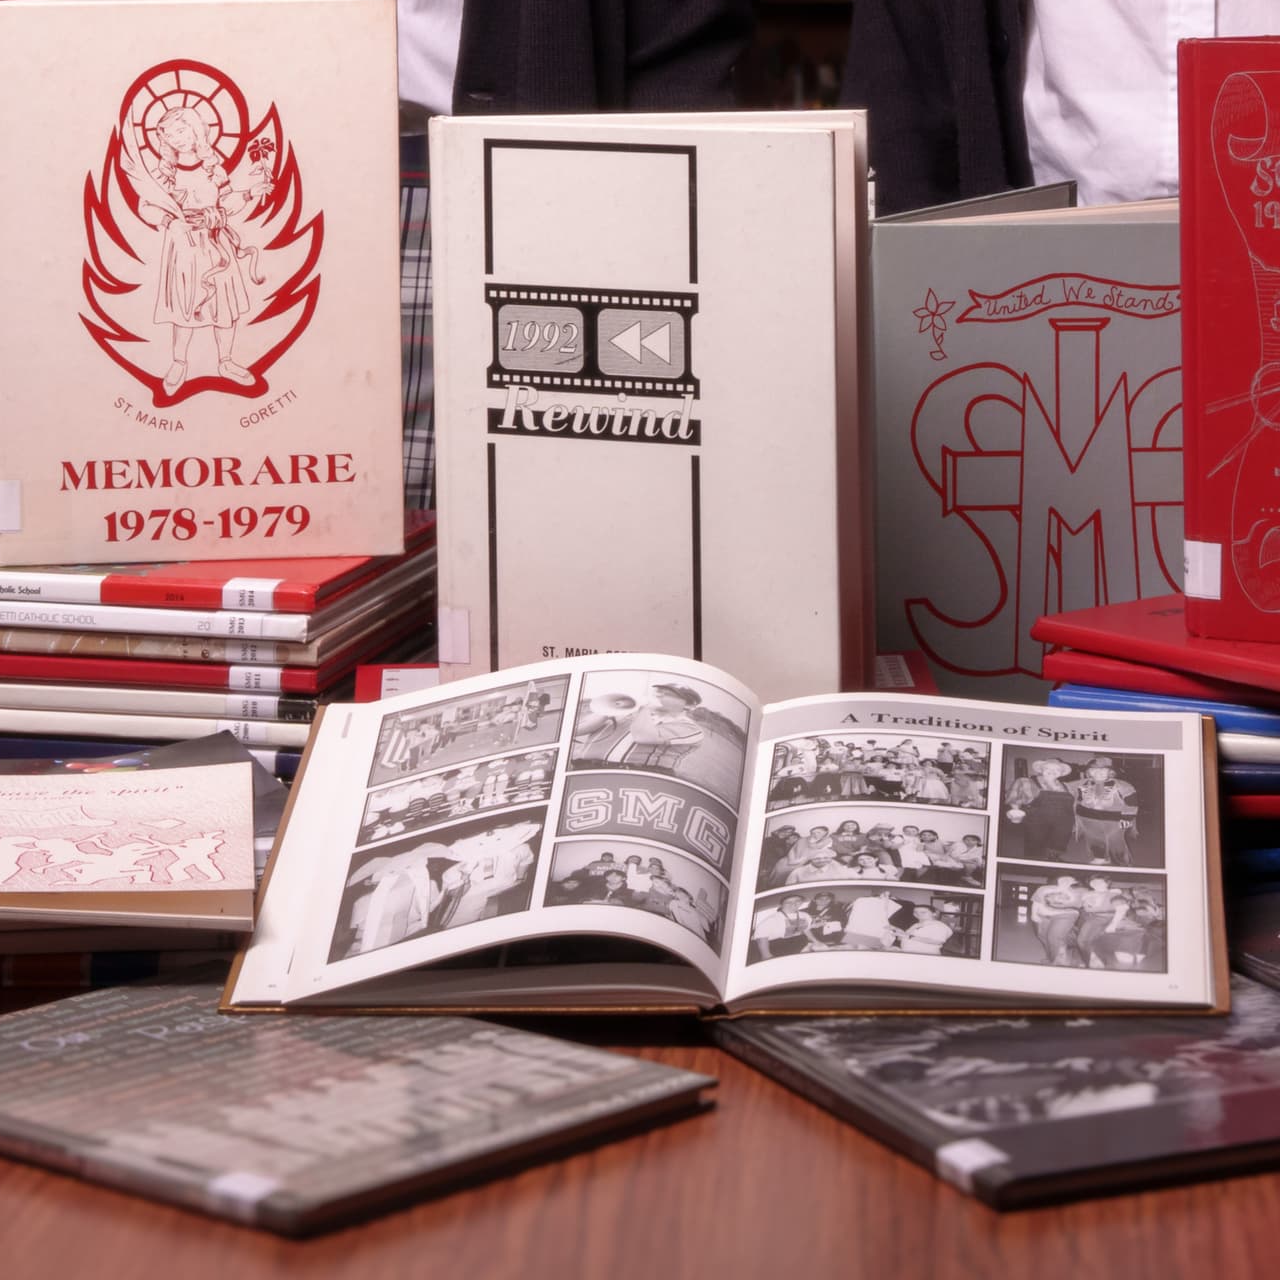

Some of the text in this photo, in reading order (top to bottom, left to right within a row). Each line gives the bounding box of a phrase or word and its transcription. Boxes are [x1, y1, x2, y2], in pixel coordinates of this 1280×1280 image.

[984, 278, 1175, 317] United We Stand
[501, 319, 579, 354] 1992
[112, 389, 298, 433] ST. MARIA GORETTI
[496, 383, 695, 440] Rewind
[59, 453, 358, 492] MEMORARE
[103, 504, 312, 543] 1978-1979
[17, 586, 42, 596] School
[19, 612, 61, 624] CATHOLIC
[62, 614, 97, 625] SCHOOL
[542, 645, 559, 659] ST.
[840, 711, 1110, 743] A Tradition of Spirit
[565, 787, 731, 868] SMG
